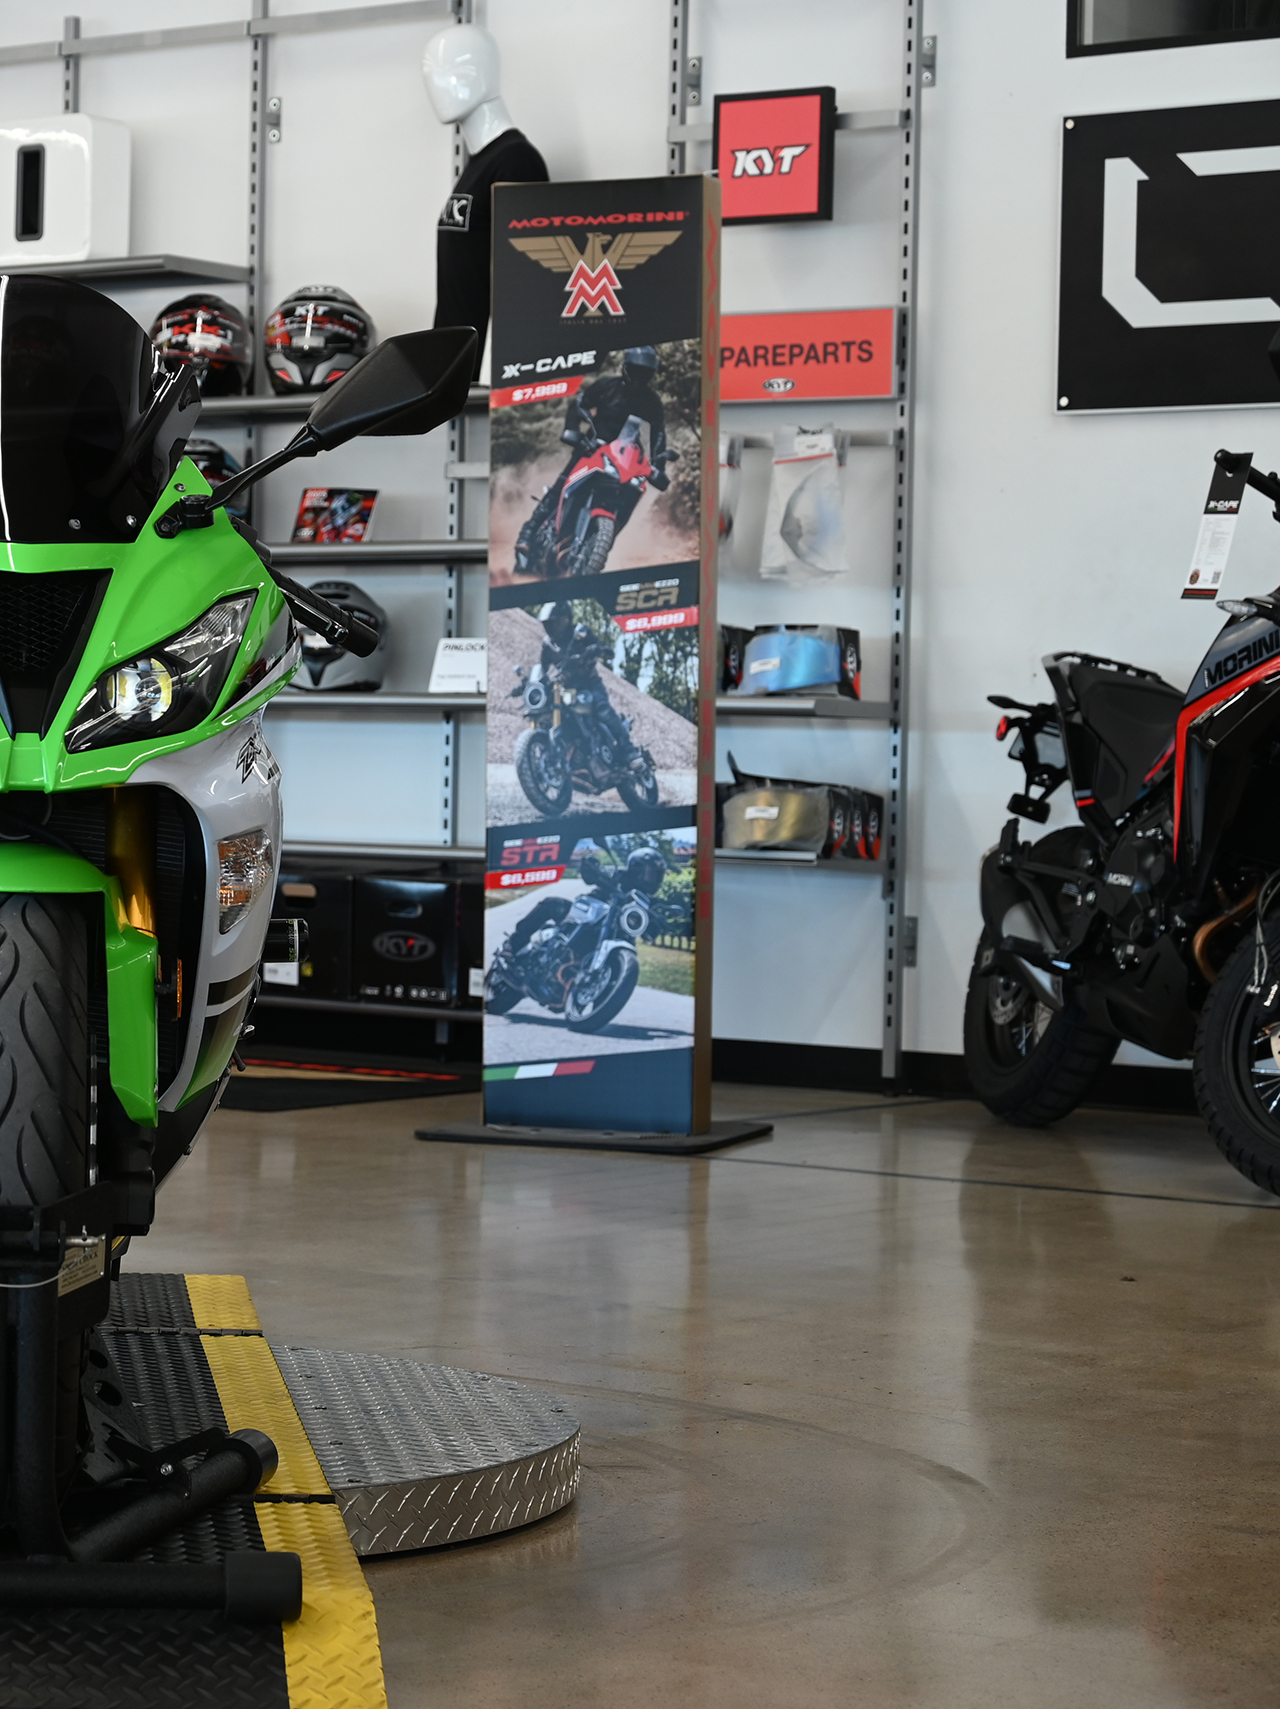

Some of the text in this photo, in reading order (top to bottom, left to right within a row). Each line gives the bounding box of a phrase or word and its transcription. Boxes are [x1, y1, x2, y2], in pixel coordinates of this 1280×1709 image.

[732, 144, 810, 178] KYT
[508, 211, 685, 229] MOTOMORINI
[501, 350, 597, 379] X-CAPE
[1207, 629, 1279, 685] MORINI
